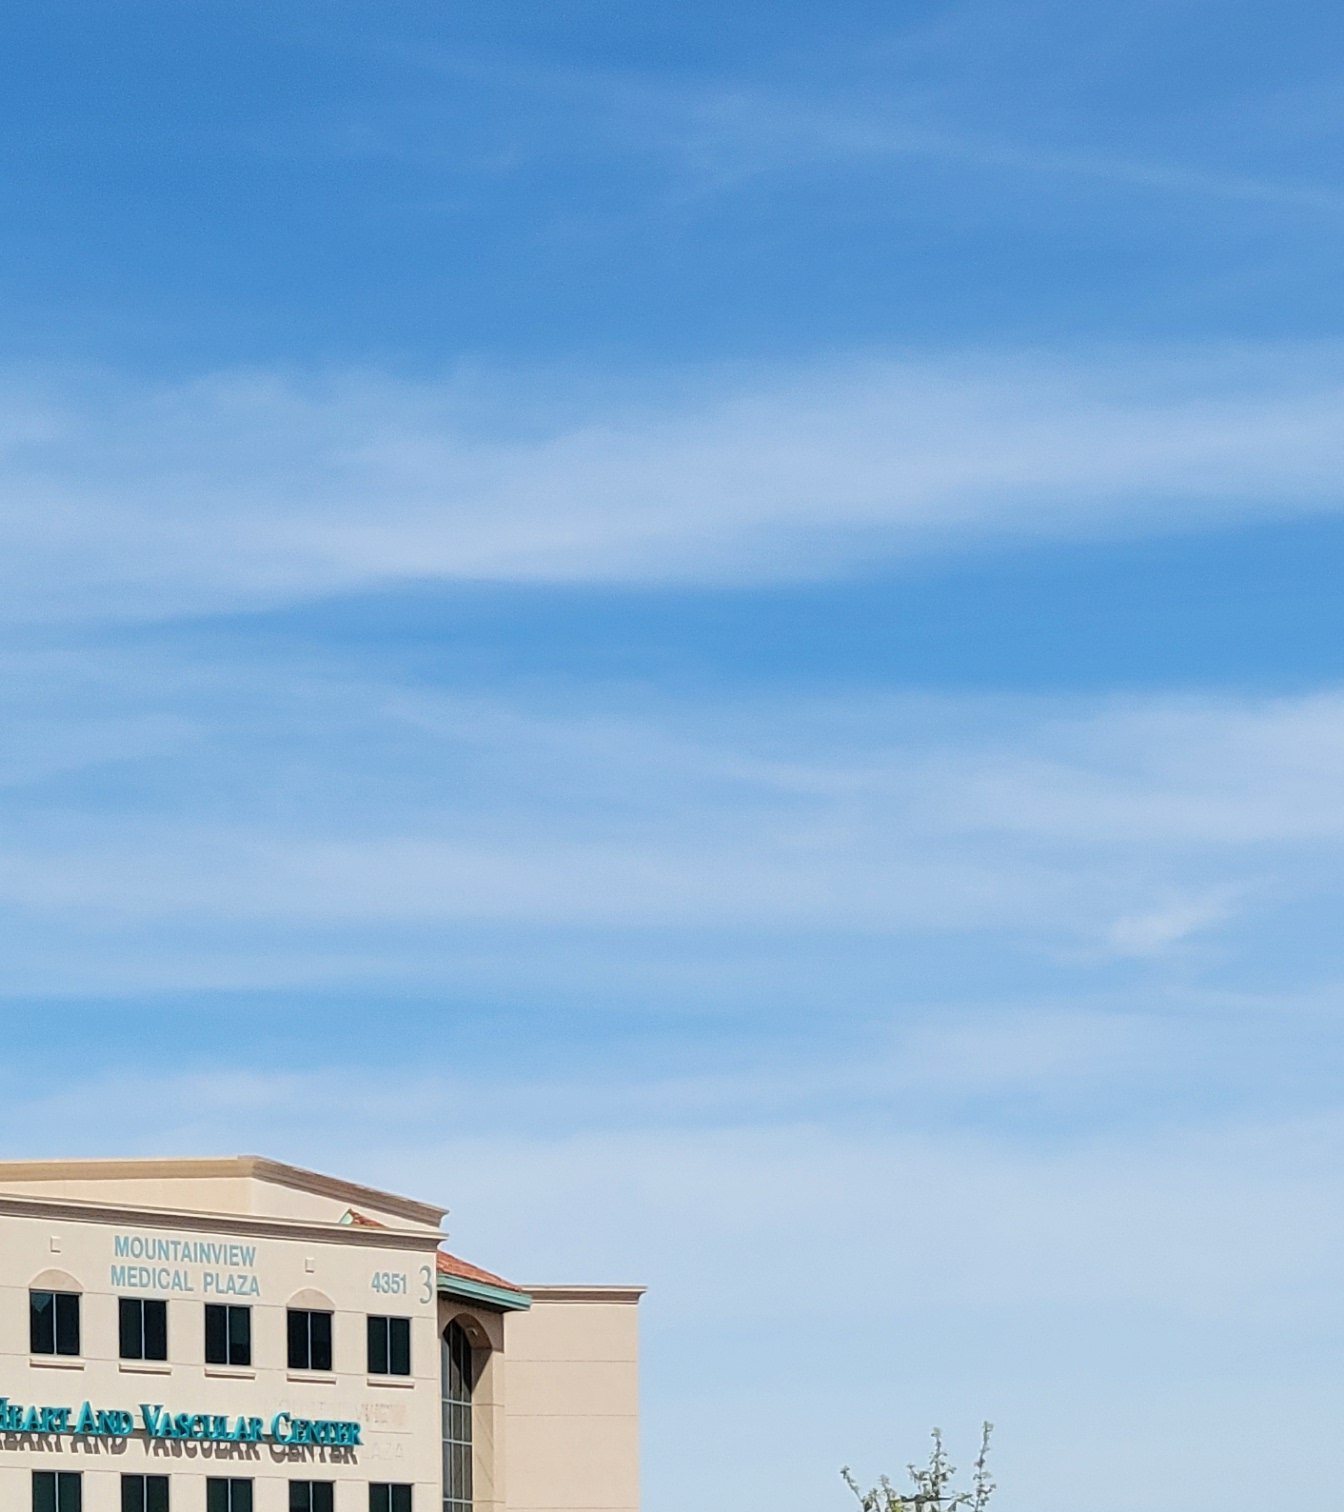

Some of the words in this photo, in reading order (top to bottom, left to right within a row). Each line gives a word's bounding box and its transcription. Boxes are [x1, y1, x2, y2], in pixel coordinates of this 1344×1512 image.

[114, 1235, 256, 1267] MOUNTAINVIEW
[110, 1265, 194, 1292] MEDICAL
[204, 1272, 260, 1297] PLAZA
[371, 1271, 407, 1294] 4351
[419, 1265, 433, 1304] 3
[138, 1403, 264, 1442] VASCULAR
[271, 1411, 364, 1446] CENTER
